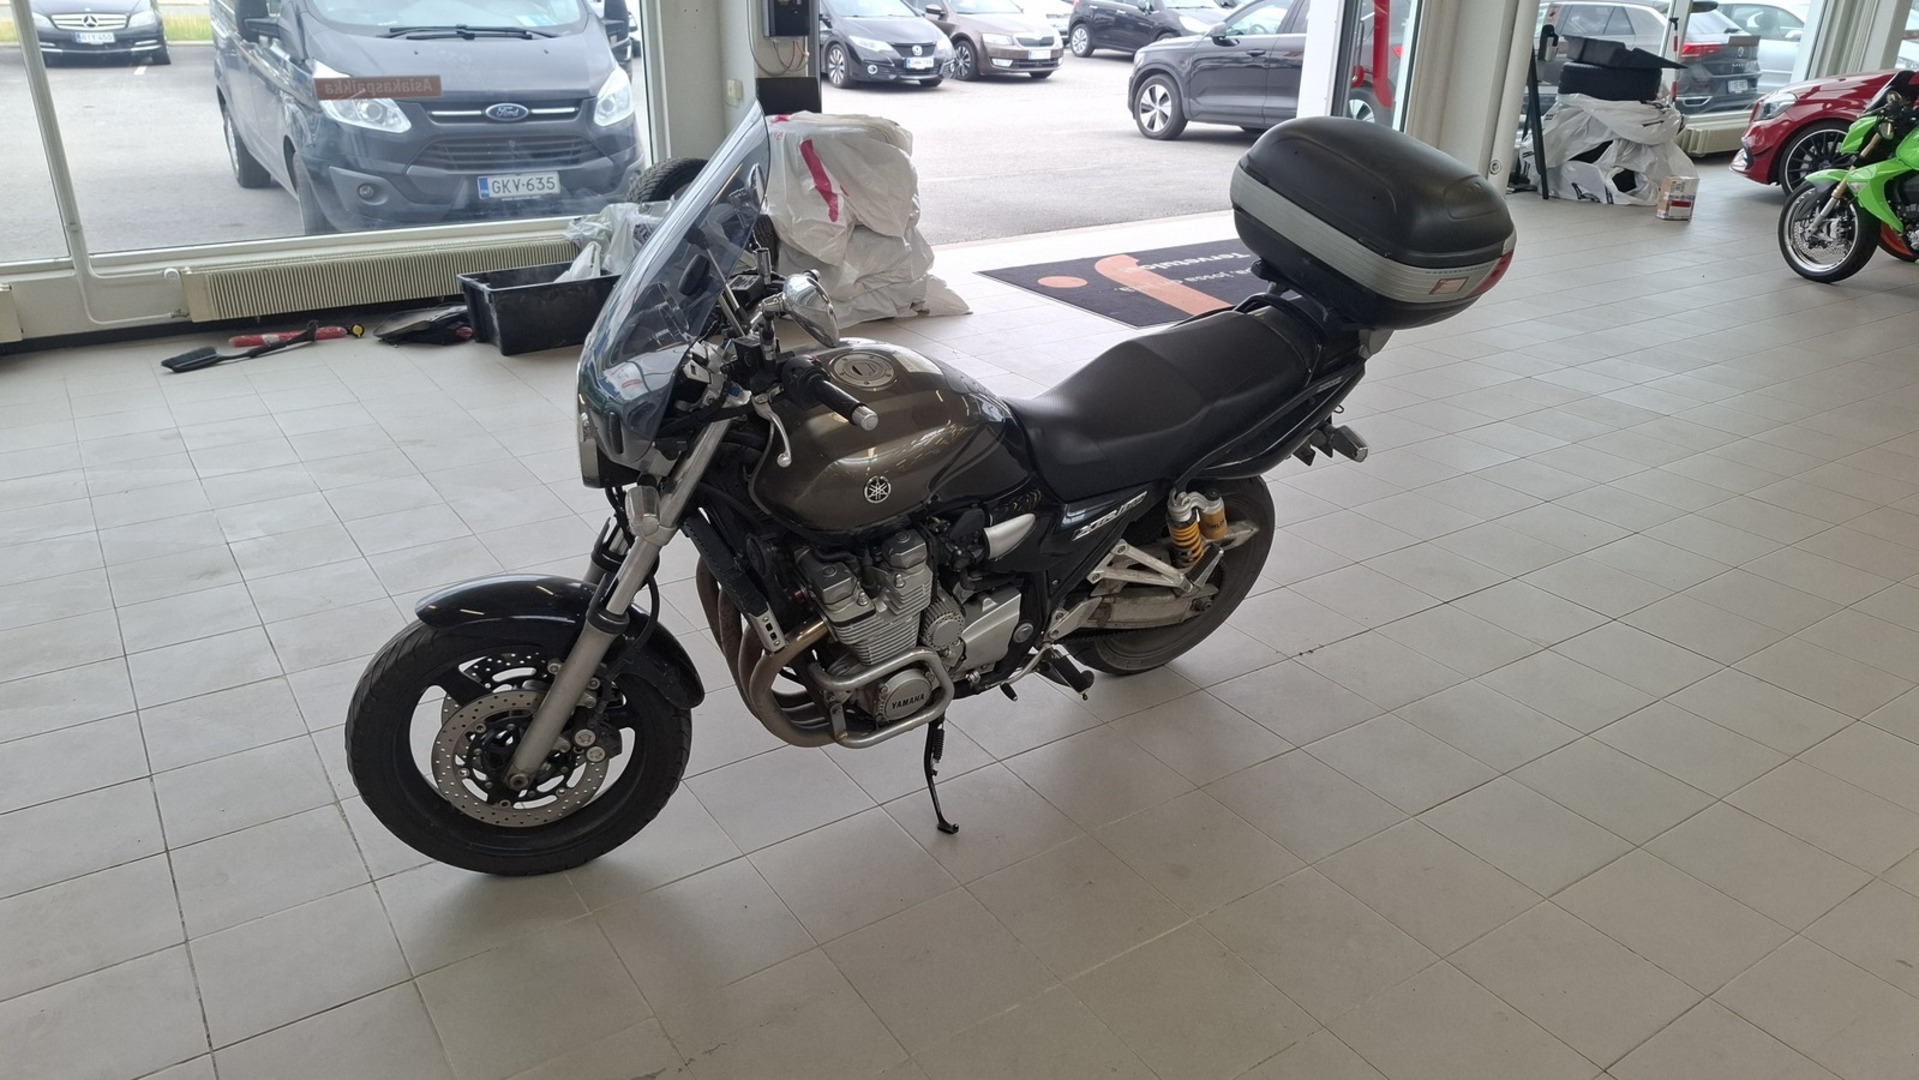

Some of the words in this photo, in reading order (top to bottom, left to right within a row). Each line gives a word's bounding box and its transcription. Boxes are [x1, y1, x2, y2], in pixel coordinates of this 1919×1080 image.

[496, 106, 519, 116] Ford
[491, 176, 555, 194] GKV-635
[892, 693, 925, 710] YAMAHA
